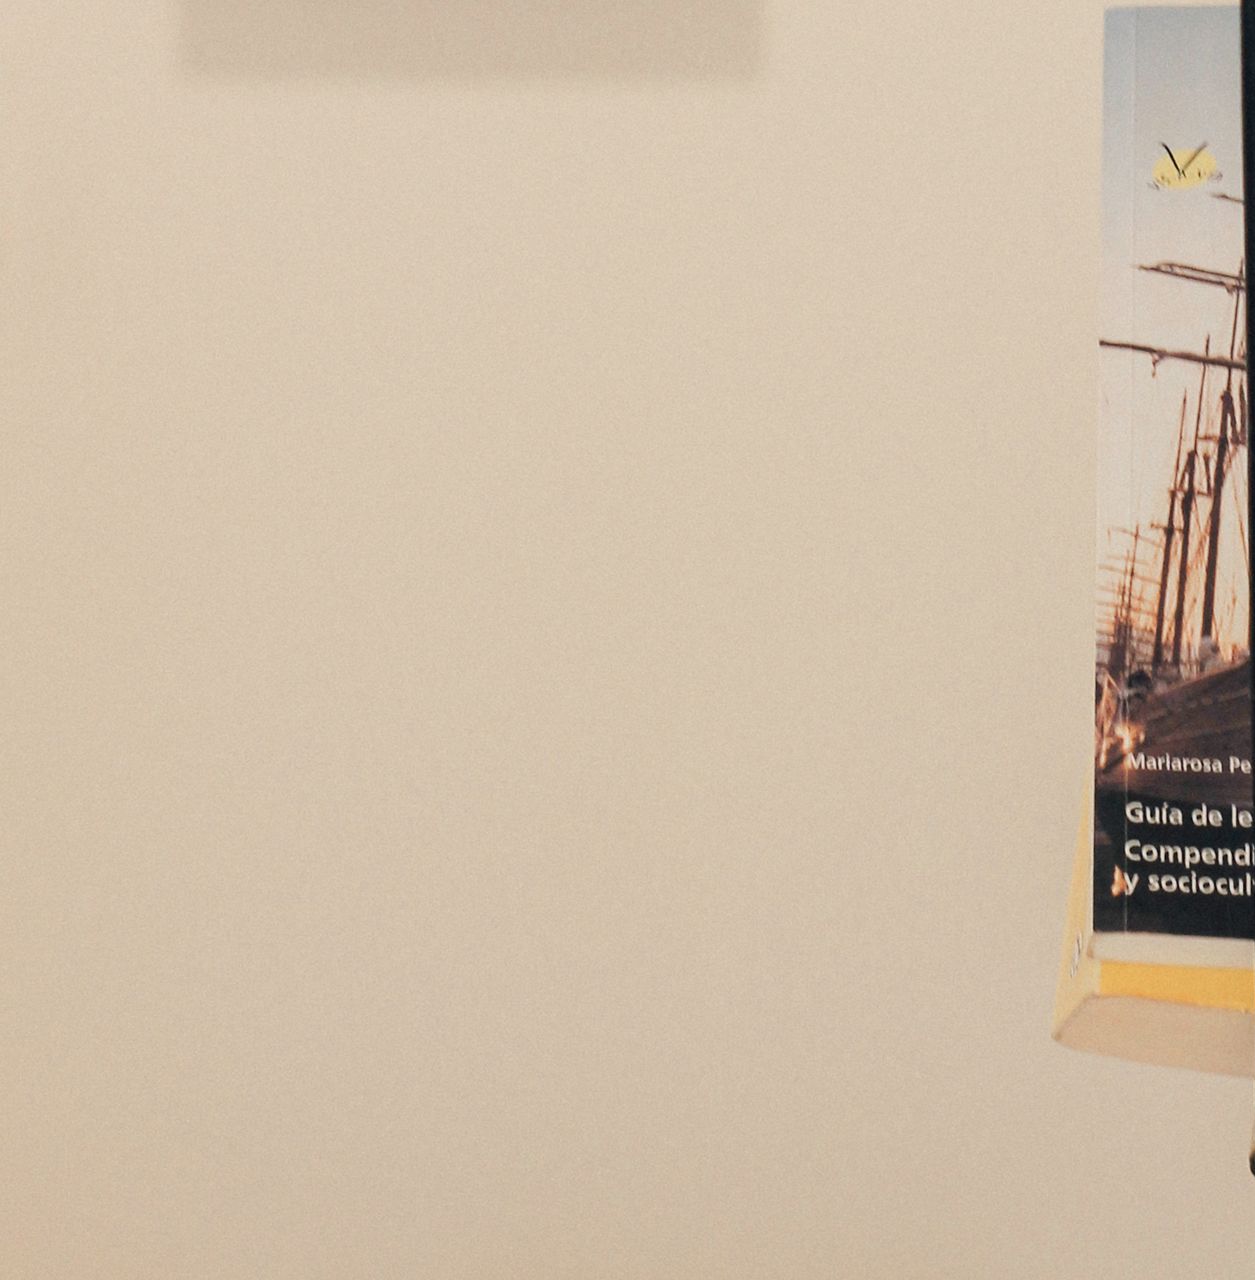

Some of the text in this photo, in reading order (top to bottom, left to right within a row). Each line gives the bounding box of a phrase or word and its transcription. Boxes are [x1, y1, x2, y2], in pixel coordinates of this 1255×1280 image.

[1127, 751, 1223, 774] Mariarosa
[1125, 801, 1184, 826] Guía
[1191, 802, 1224, 828] de
[1124, 838, 1255, 869] Compendi
[1123, 871, 1140, 896] y
